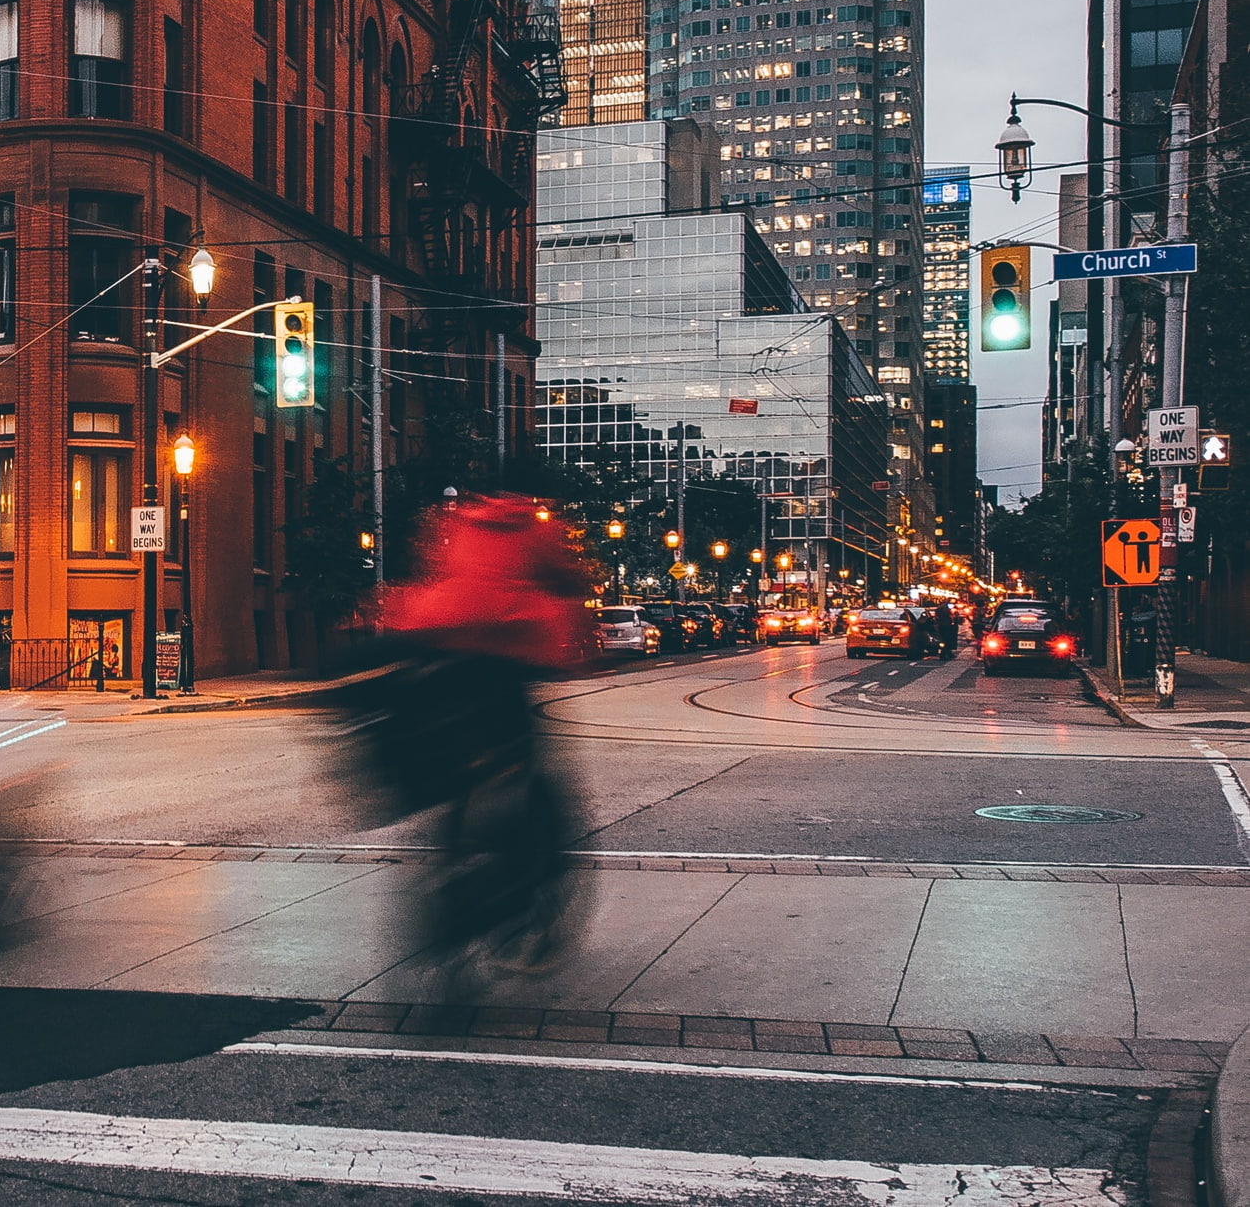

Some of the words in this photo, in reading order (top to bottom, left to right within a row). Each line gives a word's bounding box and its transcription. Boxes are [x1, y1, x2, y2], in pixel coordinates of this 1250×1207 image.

[1081, 251, 1151, 272] Church
[1156, 249, 1167, 259] St
[1159, 411, 1186, 426] ONE
[1159, 429, 1186, 443] WAY
[1150, 447, 1197, 462] BEGINS
[139, 510, 157, 521] ONE
[139, 524, 156, 534] WAY
[133, 537, 163, 548] BEGINS
